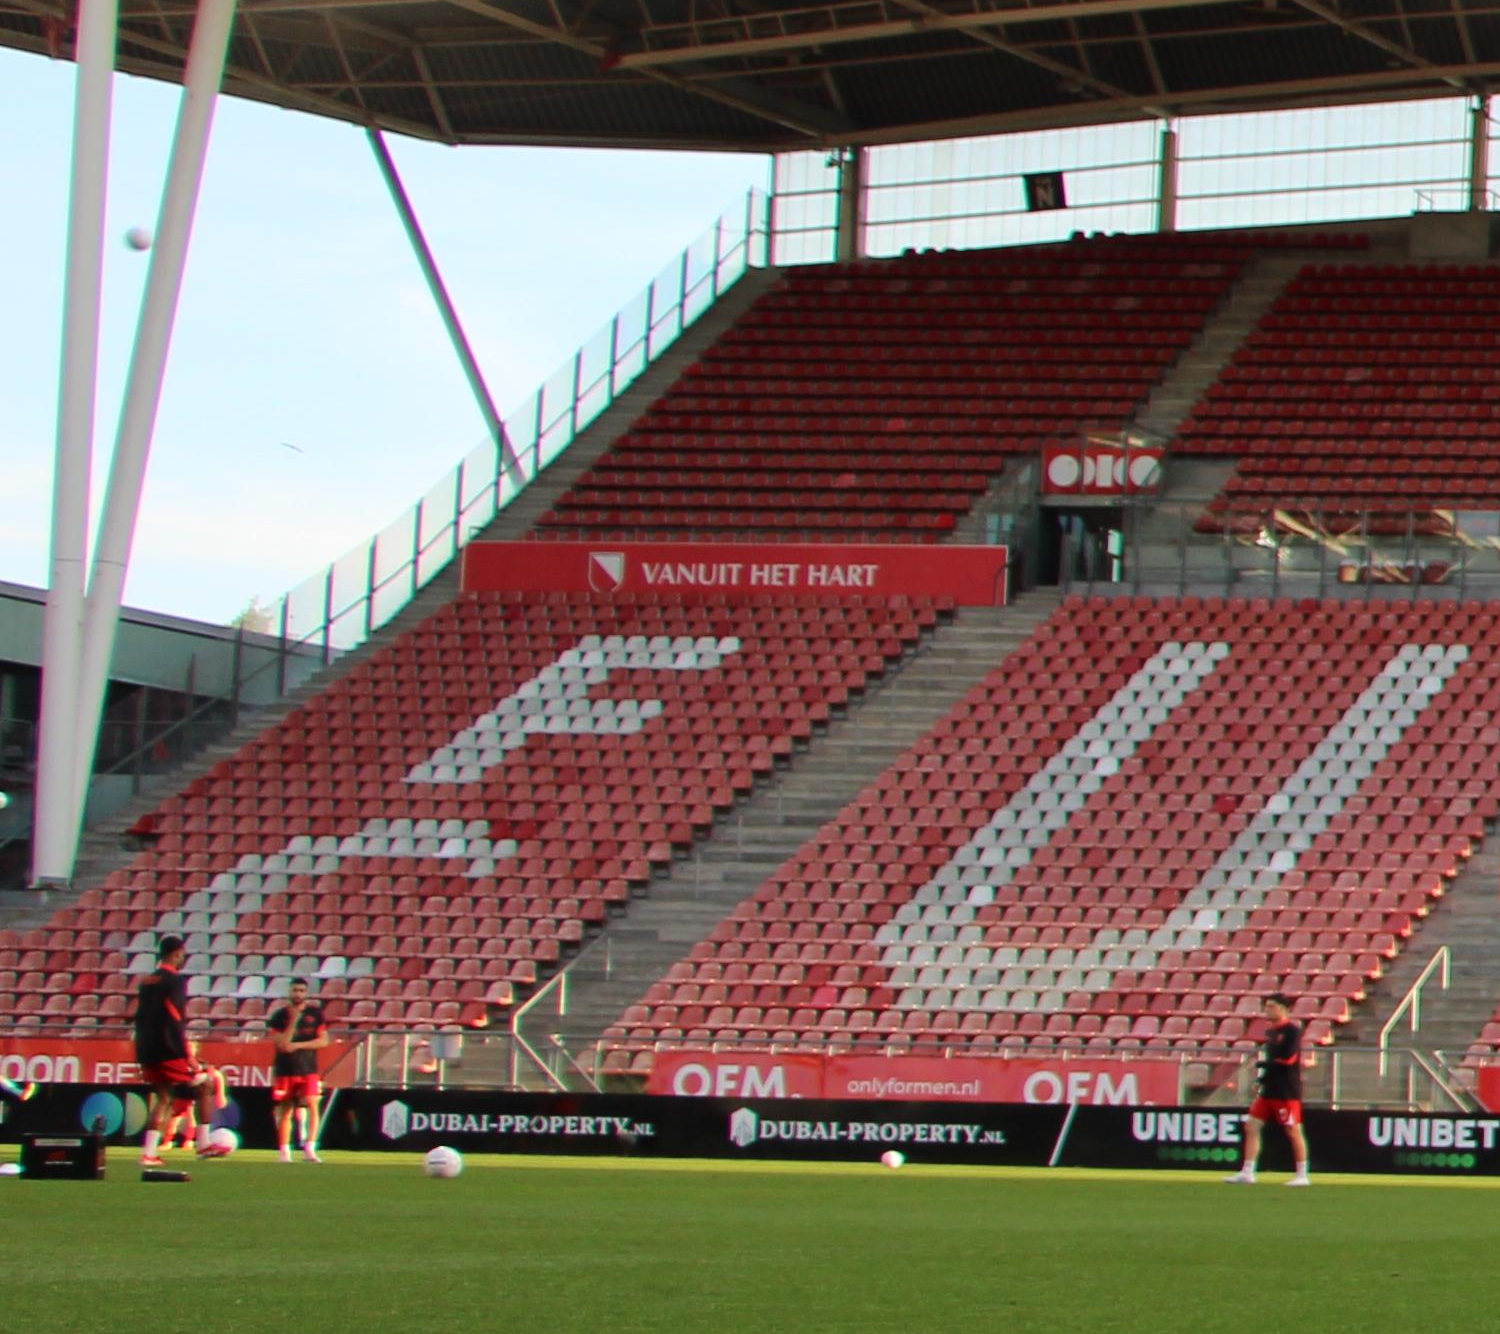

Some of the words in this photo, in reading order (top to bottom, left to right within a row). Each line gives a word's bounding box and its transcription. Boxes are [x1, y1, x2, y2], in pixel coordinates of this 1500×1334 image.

[641, 563, 742, 585] VANUIT
[751, 564, 799, 585] HET
[807, 564, 878, 586] HART
[0, 1054, 80, 1083] oon
[848, 1078, 980, 1097] onlyformen.nl
[411, 1112, 655, 1136] DUBAI-PROPERTY.NL
[759, 1120, 1006, 1144] DUBAI-PROPERTY.NL
[1132, 1112, 1250, 1143] UNIBE
[1368, 1117, 1500, 1149] UNIBET
